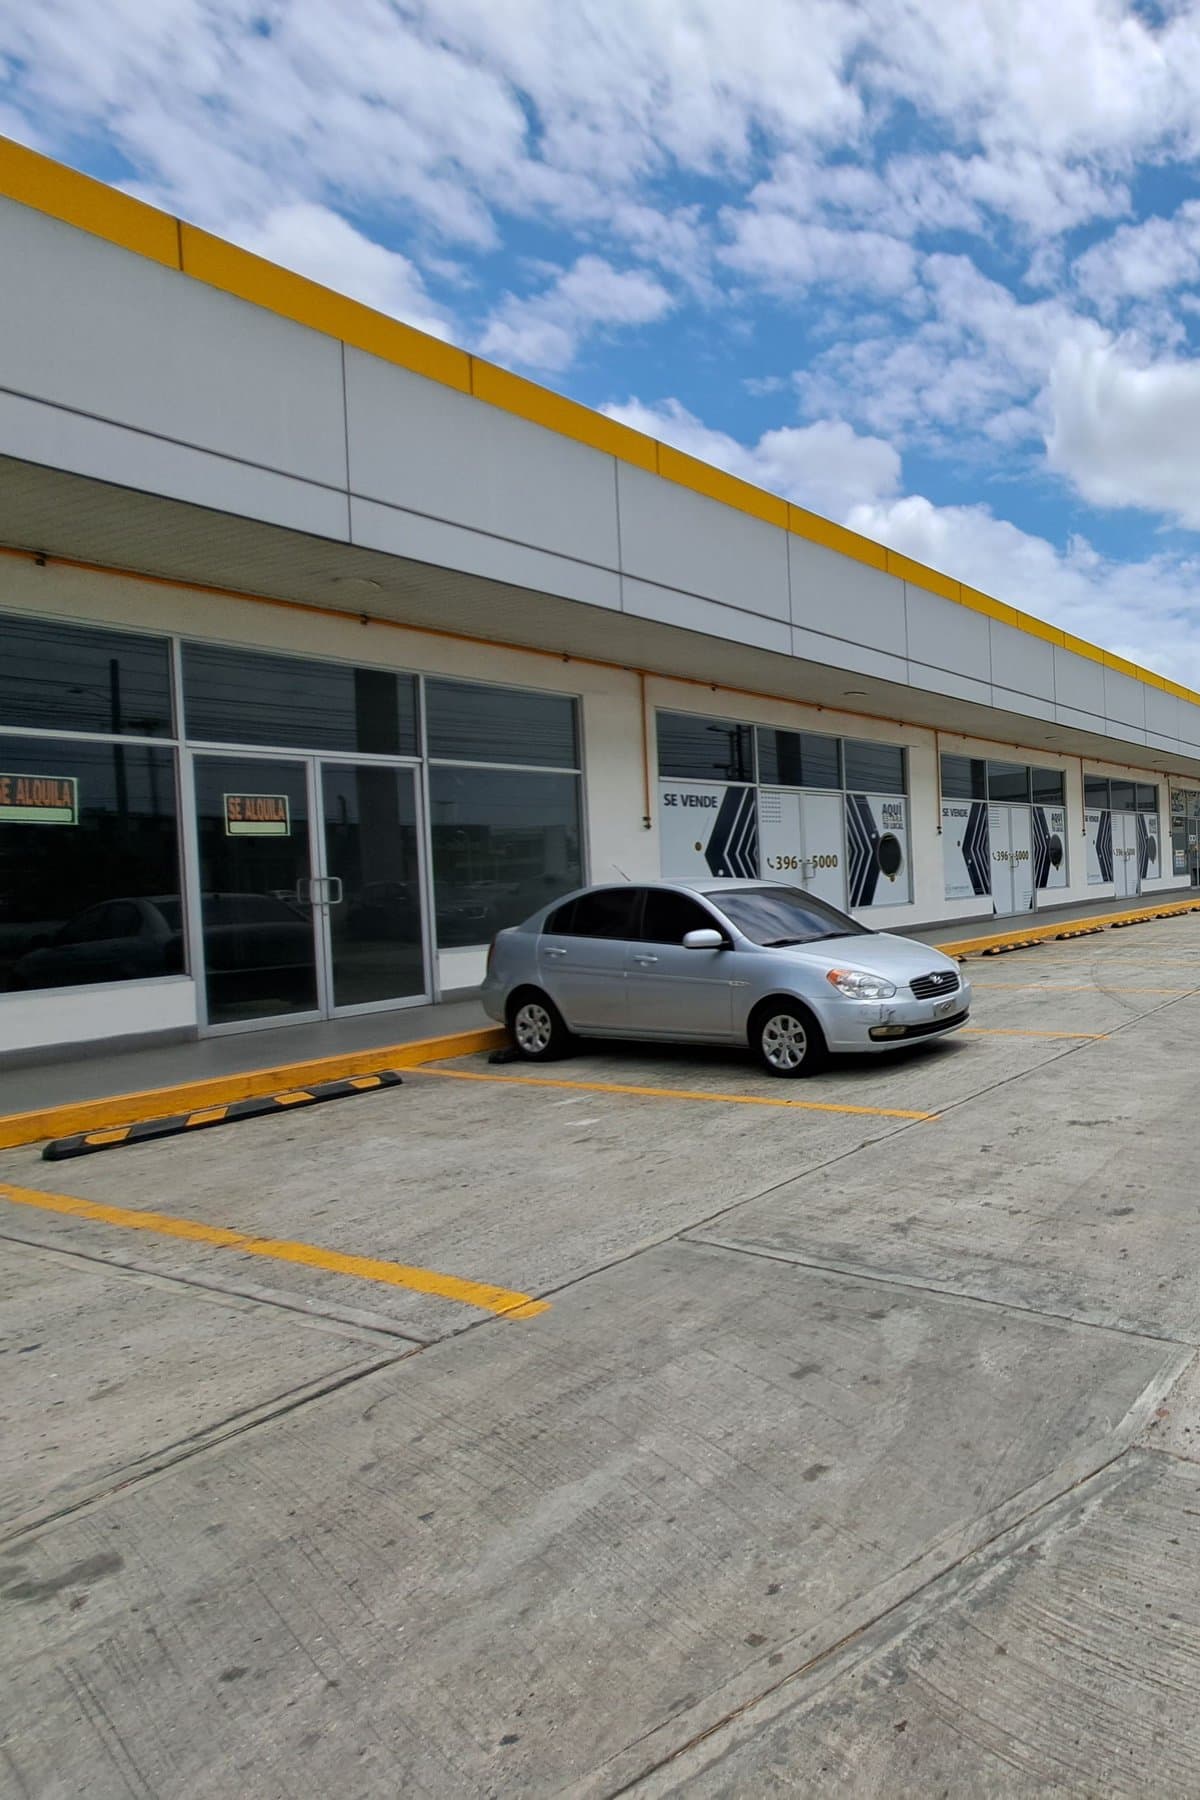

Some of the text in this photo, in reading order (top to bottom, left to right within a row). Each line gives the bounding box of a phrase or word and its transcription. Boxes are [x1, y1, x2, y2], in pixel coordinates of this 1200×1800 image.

[15, 778, 71, 806] ALQUILA
[663, 791, 718, 808] SE VENDE
[229, 797, 286, 820] SE ALQUILA
[943, 808, 968, 818] SE VENDE
